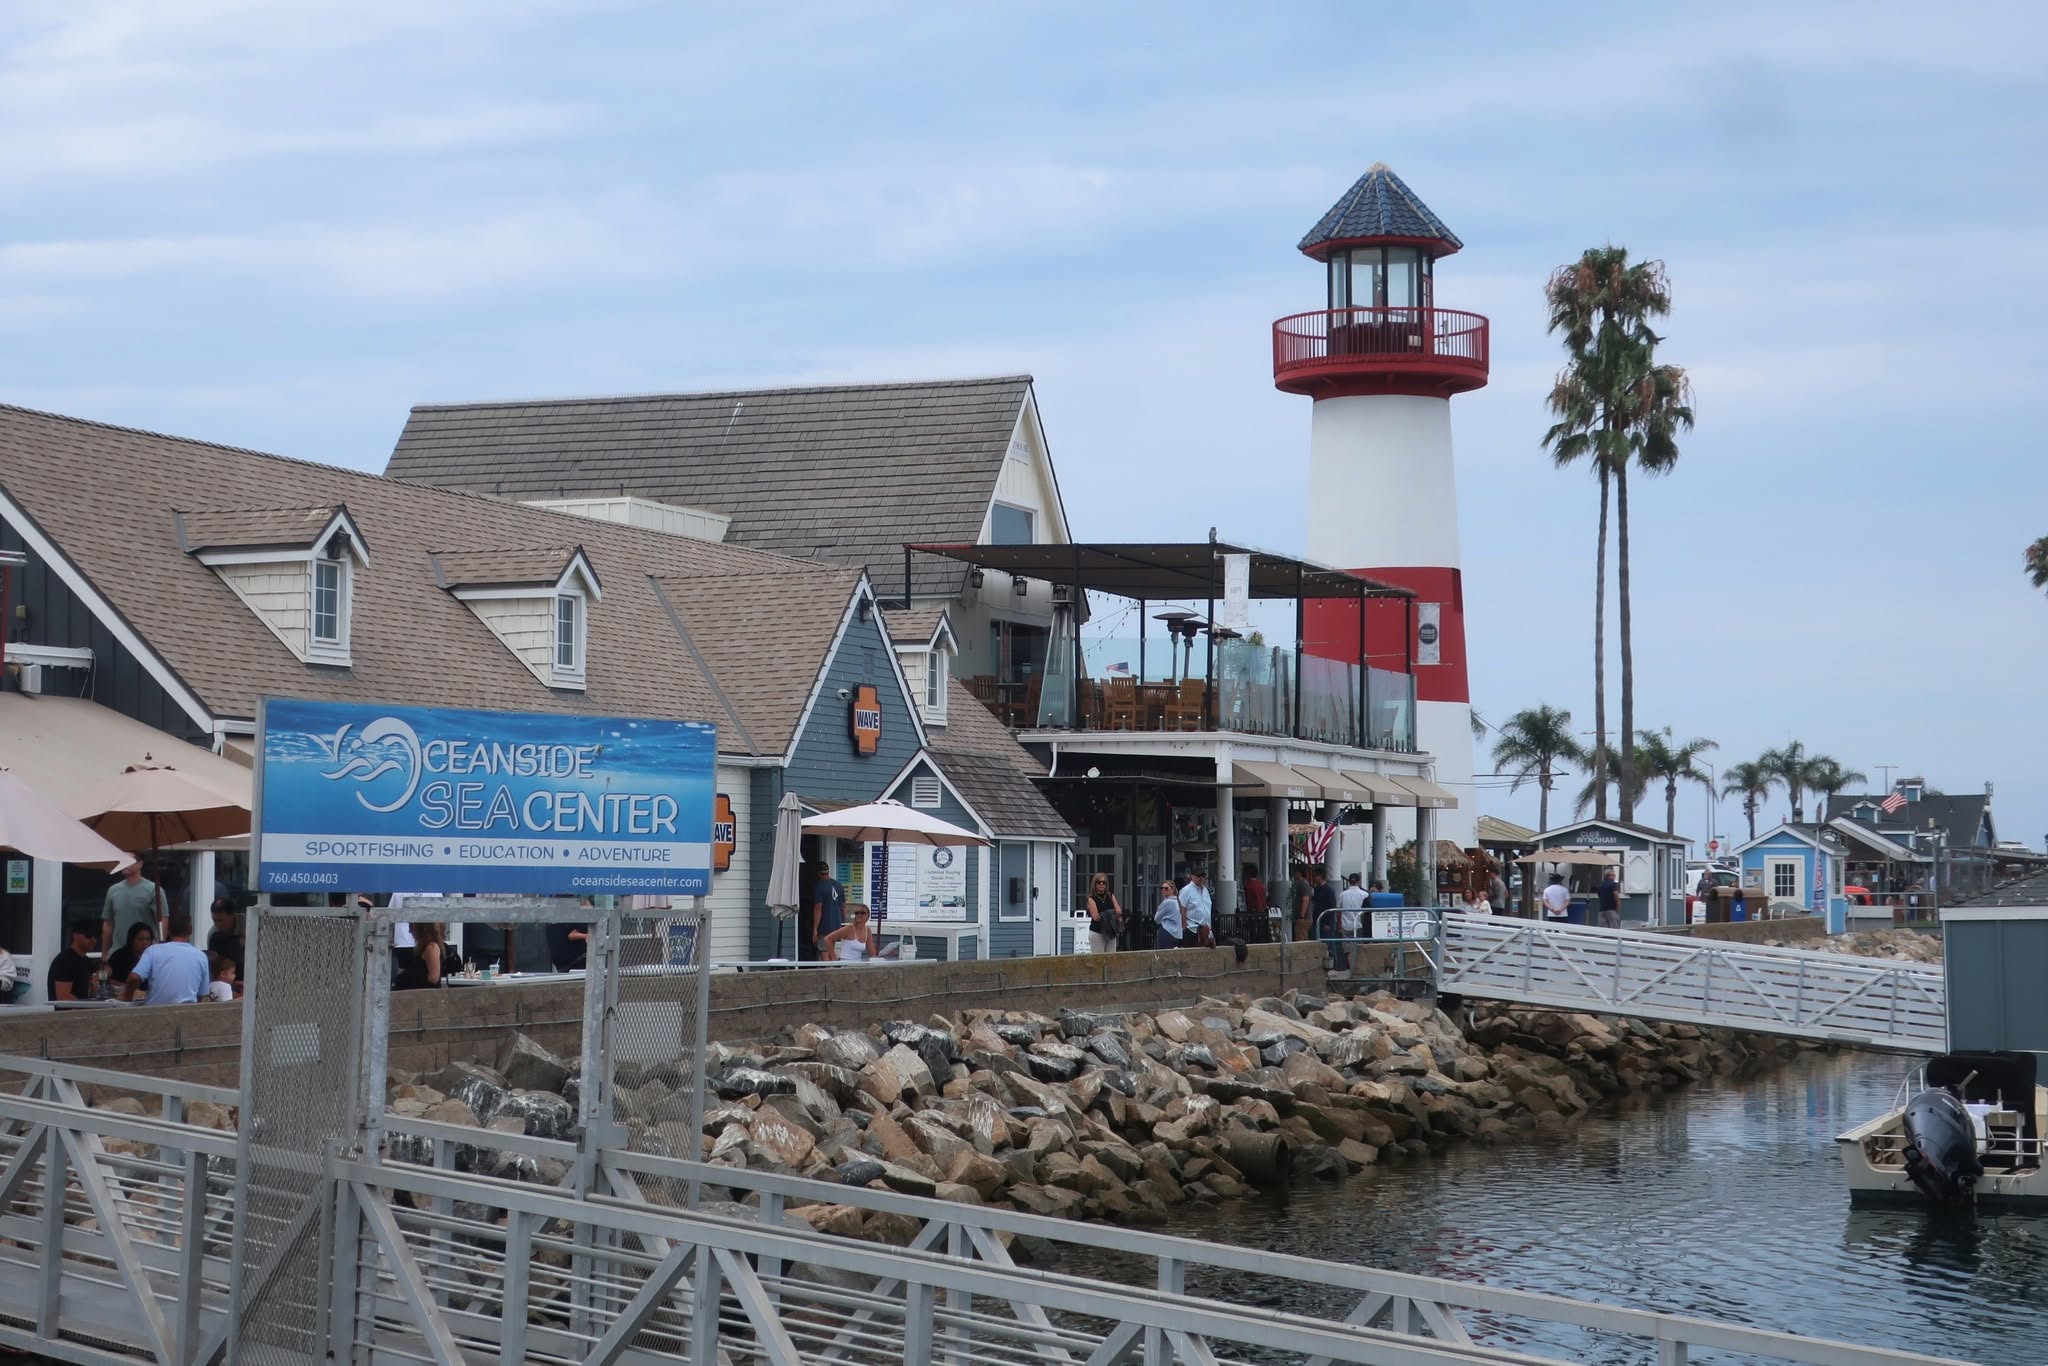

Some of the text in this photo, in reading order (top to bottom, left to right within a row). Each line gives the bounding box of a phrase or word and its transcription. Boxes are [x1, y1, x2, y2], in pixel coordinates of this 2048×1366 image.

[856, 710, 879, 729] WAVE
[418, 780, 680, 834] SEA CENTER
[714, 823, 732, 842] AVE
[304, 841, 671, 862] SPORTFISHING EDUCATION ADVENTURE
[268, 872, 339, 884] 760.450.0403
[571, 873, 703, 888] oceansideseacenter.com
